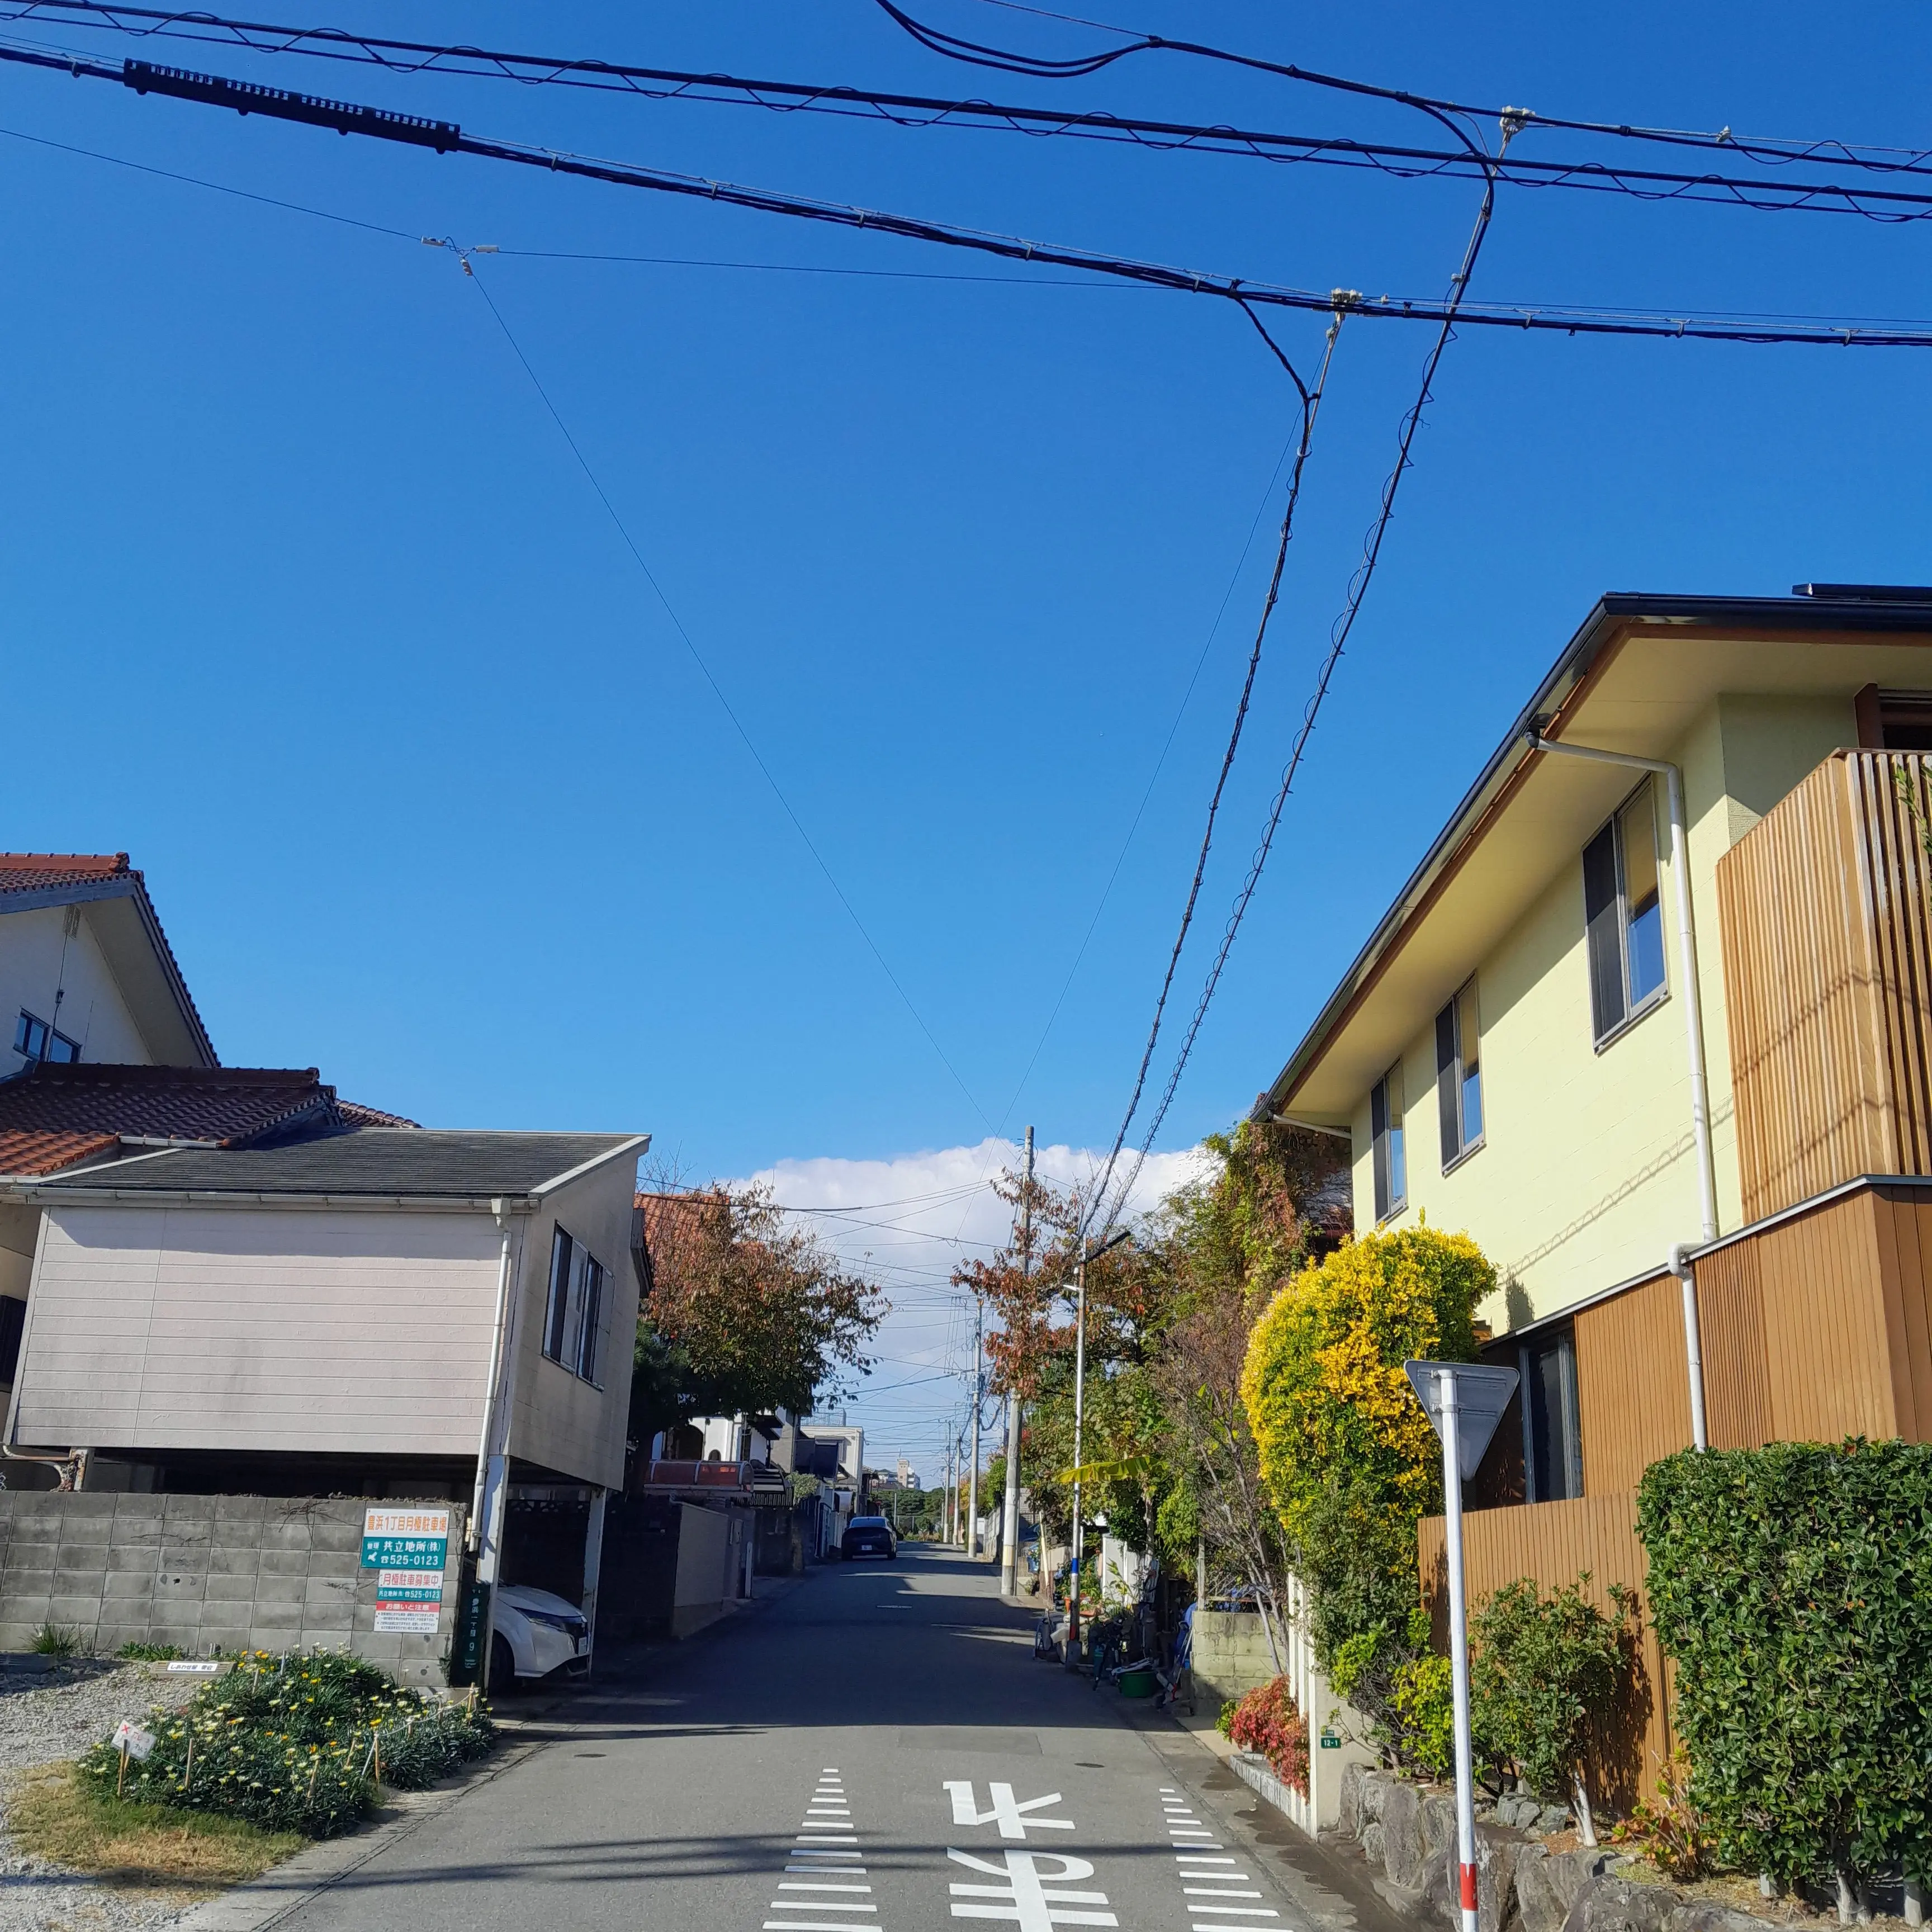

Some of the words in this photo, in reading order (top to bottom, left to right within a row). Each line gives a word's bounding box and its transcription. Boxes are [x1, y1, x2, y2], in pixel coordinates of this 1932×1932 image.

[390, 1555, 438, 1566] 525-0123
[383, 1573, 438, 1587] 月極駐車募集中
